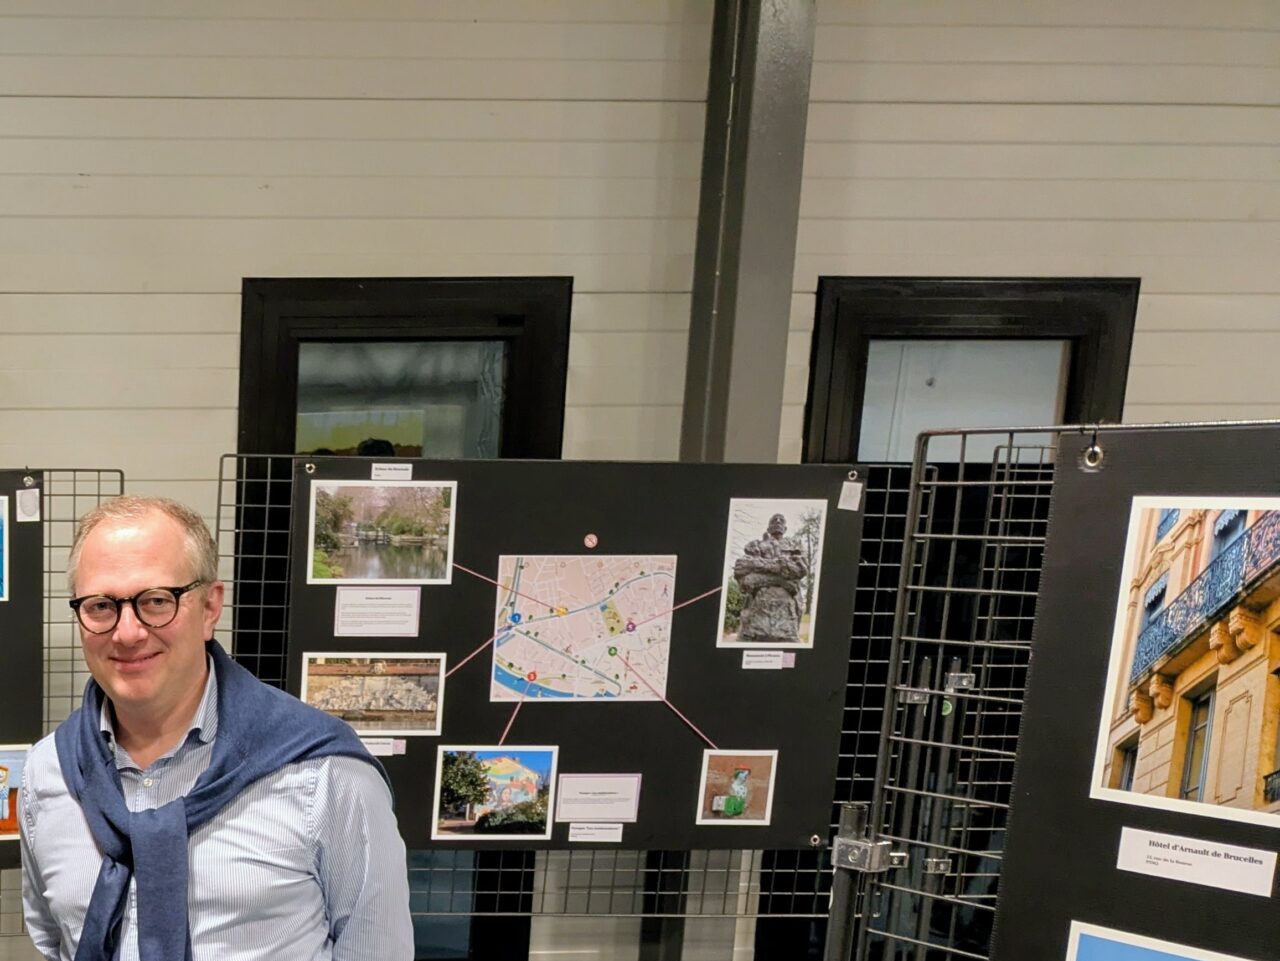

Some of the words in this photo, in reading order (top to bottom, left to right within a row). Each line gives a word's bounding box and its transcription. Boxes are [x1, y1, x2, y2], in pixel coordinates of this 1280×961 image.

[1149, 839, 1170, 850] Hôtel
[1171, 844, 1209, 856] d'Arnault
[1211, 850, 1221, 858] de
[1223, 853, 1264, 865] Brucelles
